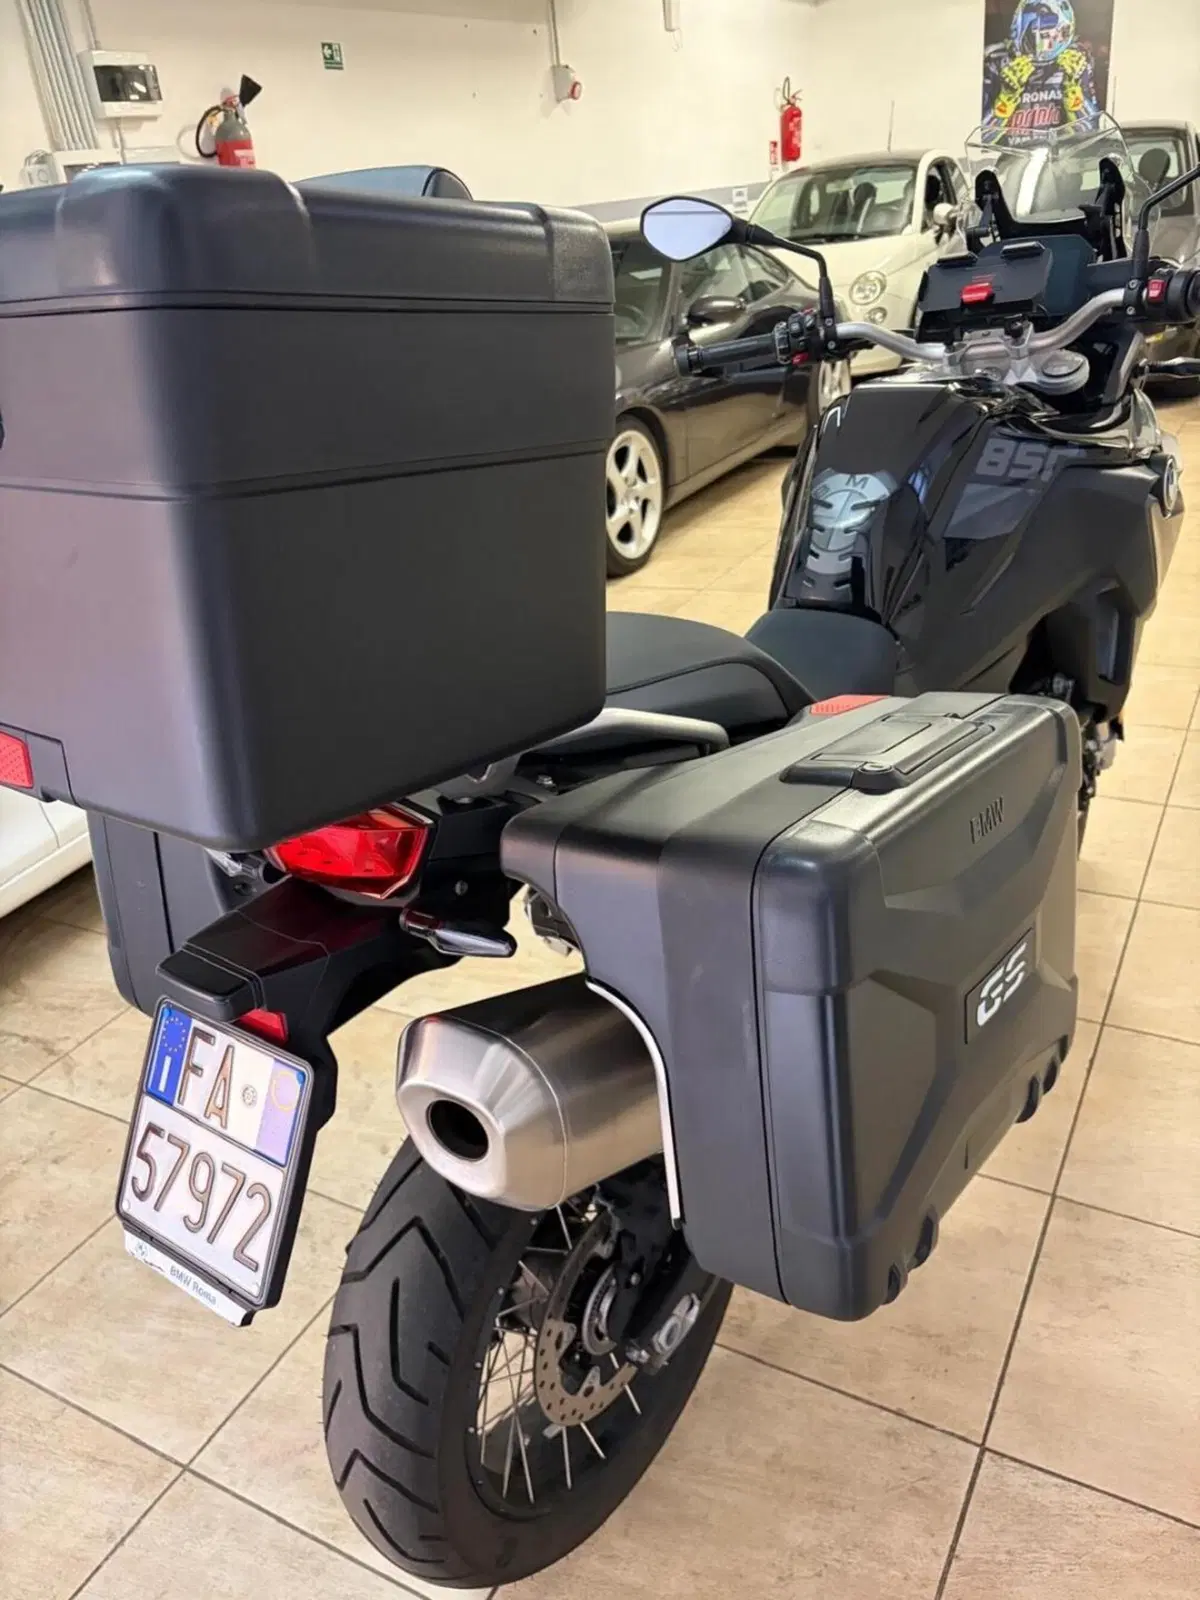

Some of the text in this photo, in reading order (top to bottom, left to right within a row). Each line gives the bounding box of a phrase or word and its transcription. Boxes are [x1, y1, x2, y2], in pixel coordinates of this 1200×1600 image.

[970, 796, 1003, 844] BMW
[977, 942, 1027, 1026] GS
[177, 1027, 235, 1129] FA
[131, 1122, 273, 1272] 57972
[170, 1265, 217, 1305] BMW Roma
